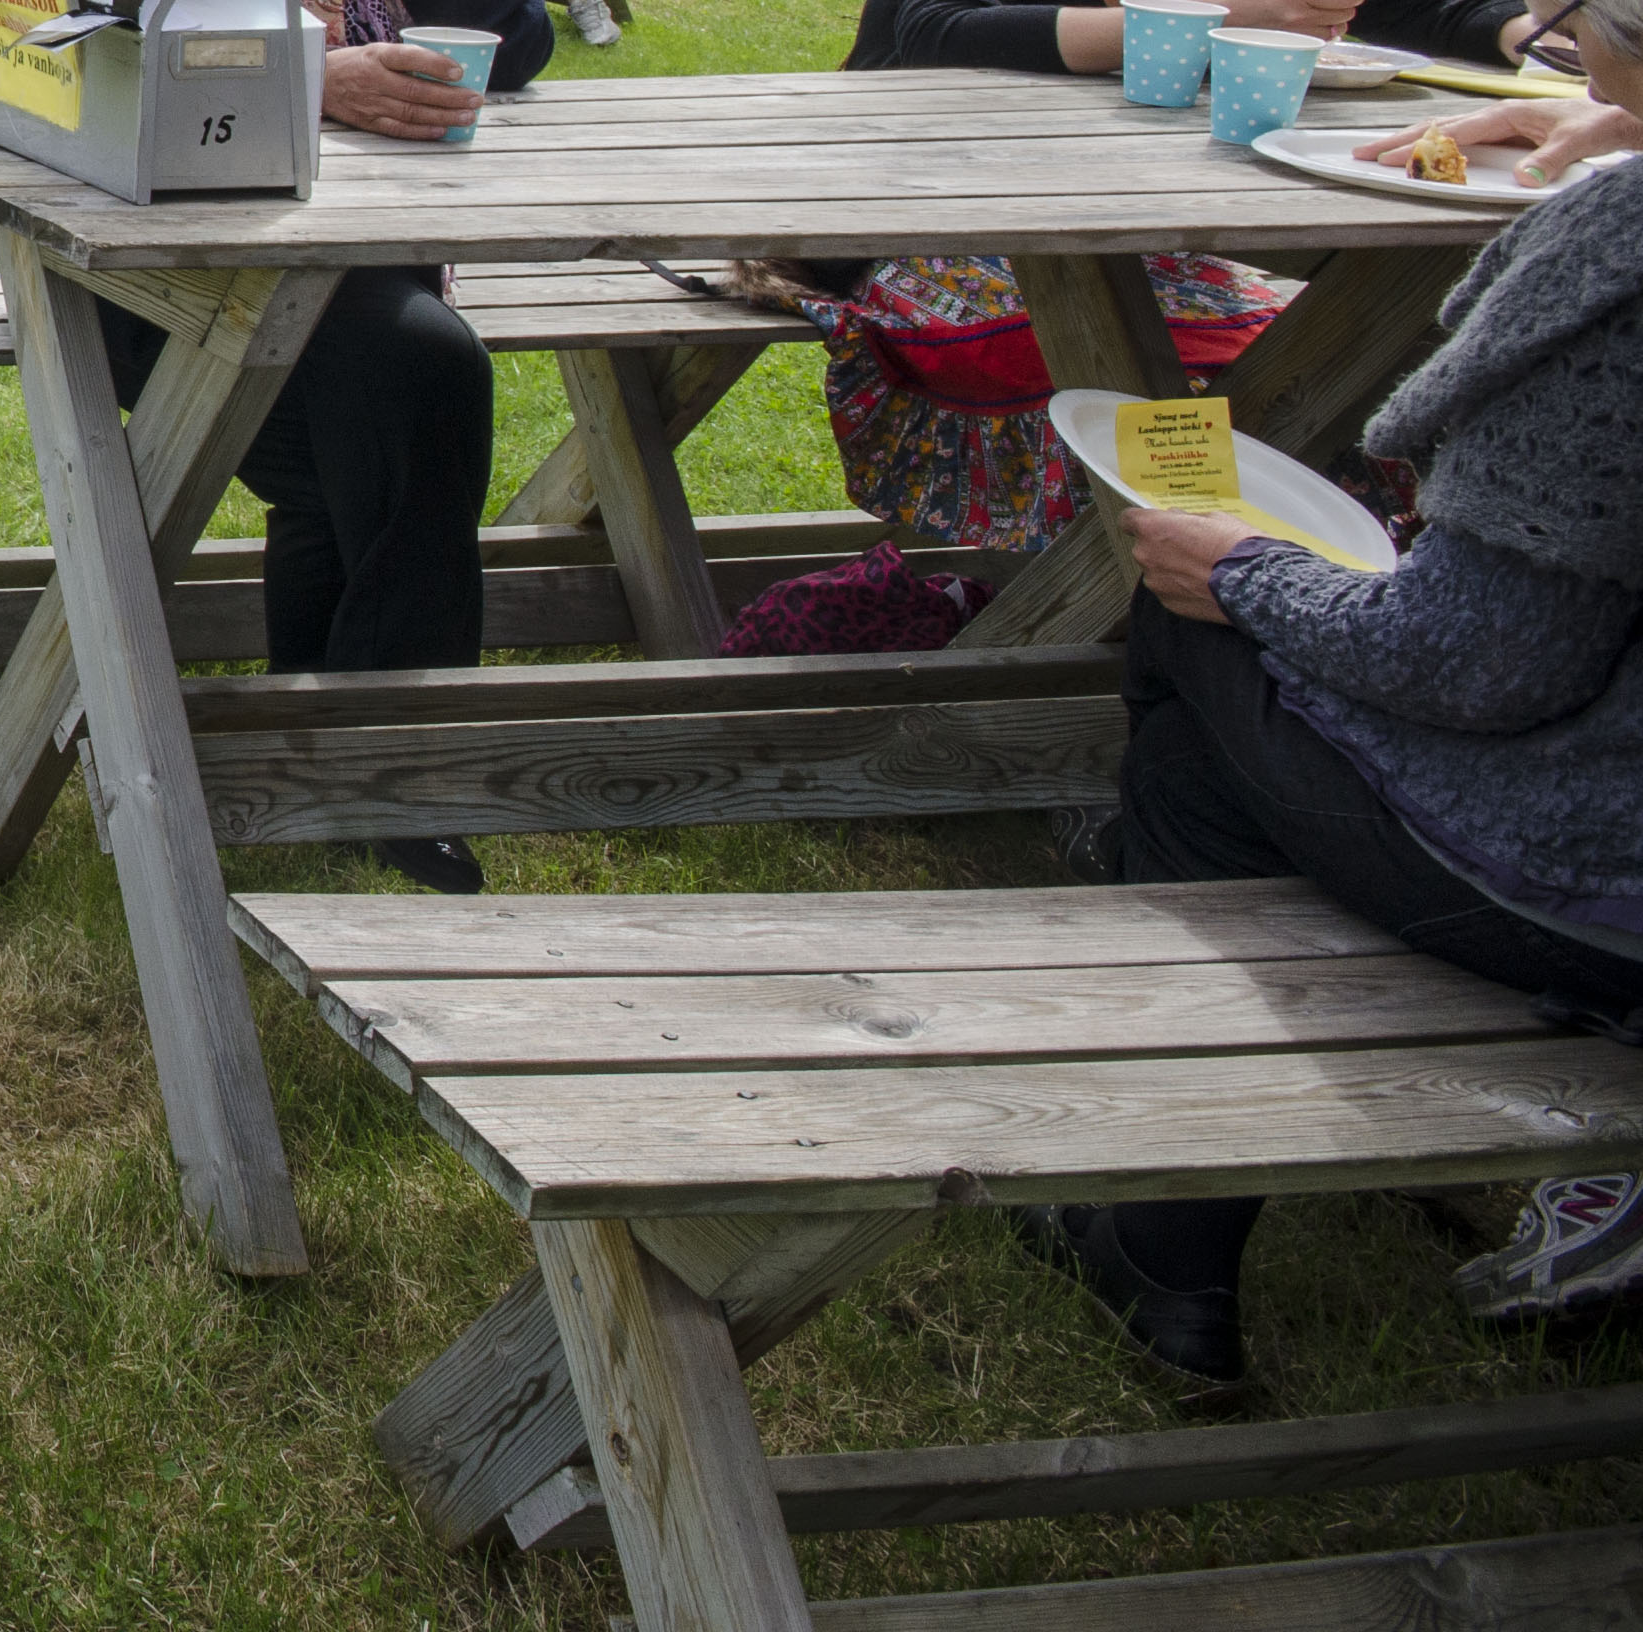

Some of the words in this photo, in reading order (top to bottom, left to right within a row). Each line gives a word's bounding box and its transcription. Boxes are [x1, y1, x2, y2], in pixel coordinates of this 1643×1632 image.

[13, 45, 24, 68] ja
[28, 52, 73, 84] vanhoja
[200, 114, 236, 146] 15
